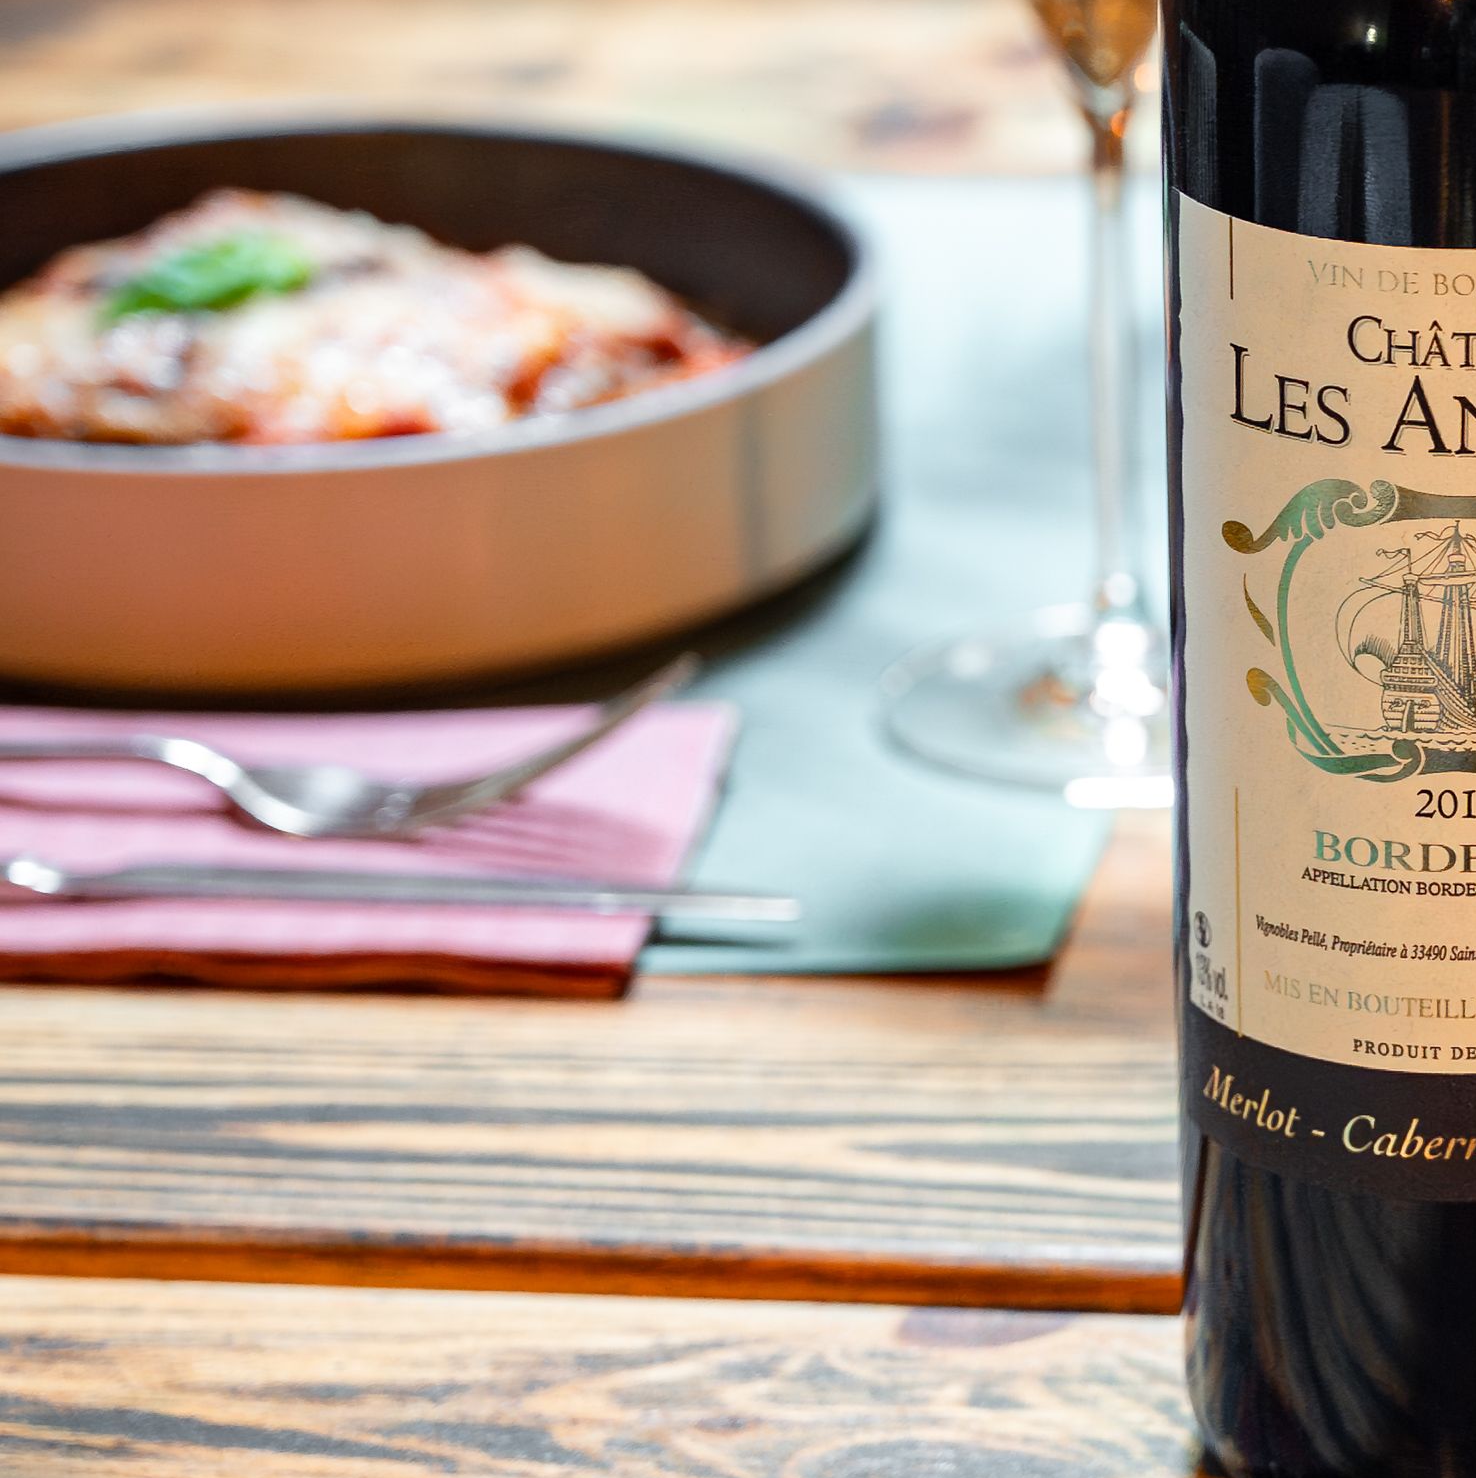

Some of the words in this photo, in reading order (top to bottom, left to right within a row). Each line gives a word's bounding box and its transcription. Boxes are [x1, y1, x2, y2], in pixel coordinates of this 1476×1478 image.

[1307, 259, 1364, 291] VIN
[1378, 270, 1420, 296] DE
[1230, 343, 1352, 446] LES
[1301, 866, 1412, 895] APPELLATION
[1256, 914, 1298, 942] Vignobles
[1332, 935, 1397, 958] Propriétaire
[1410, 944, 1447, 961] 33490
[1263, 969, 1301, 1000] MIS
[1308, 983, 1339, 1007] EN
[1352, 1038, 1442, 1060] PRODUIT
[1451, 1046, 1476, 1060] DE
[1203, 1065, 1299, 1138] Merlot
